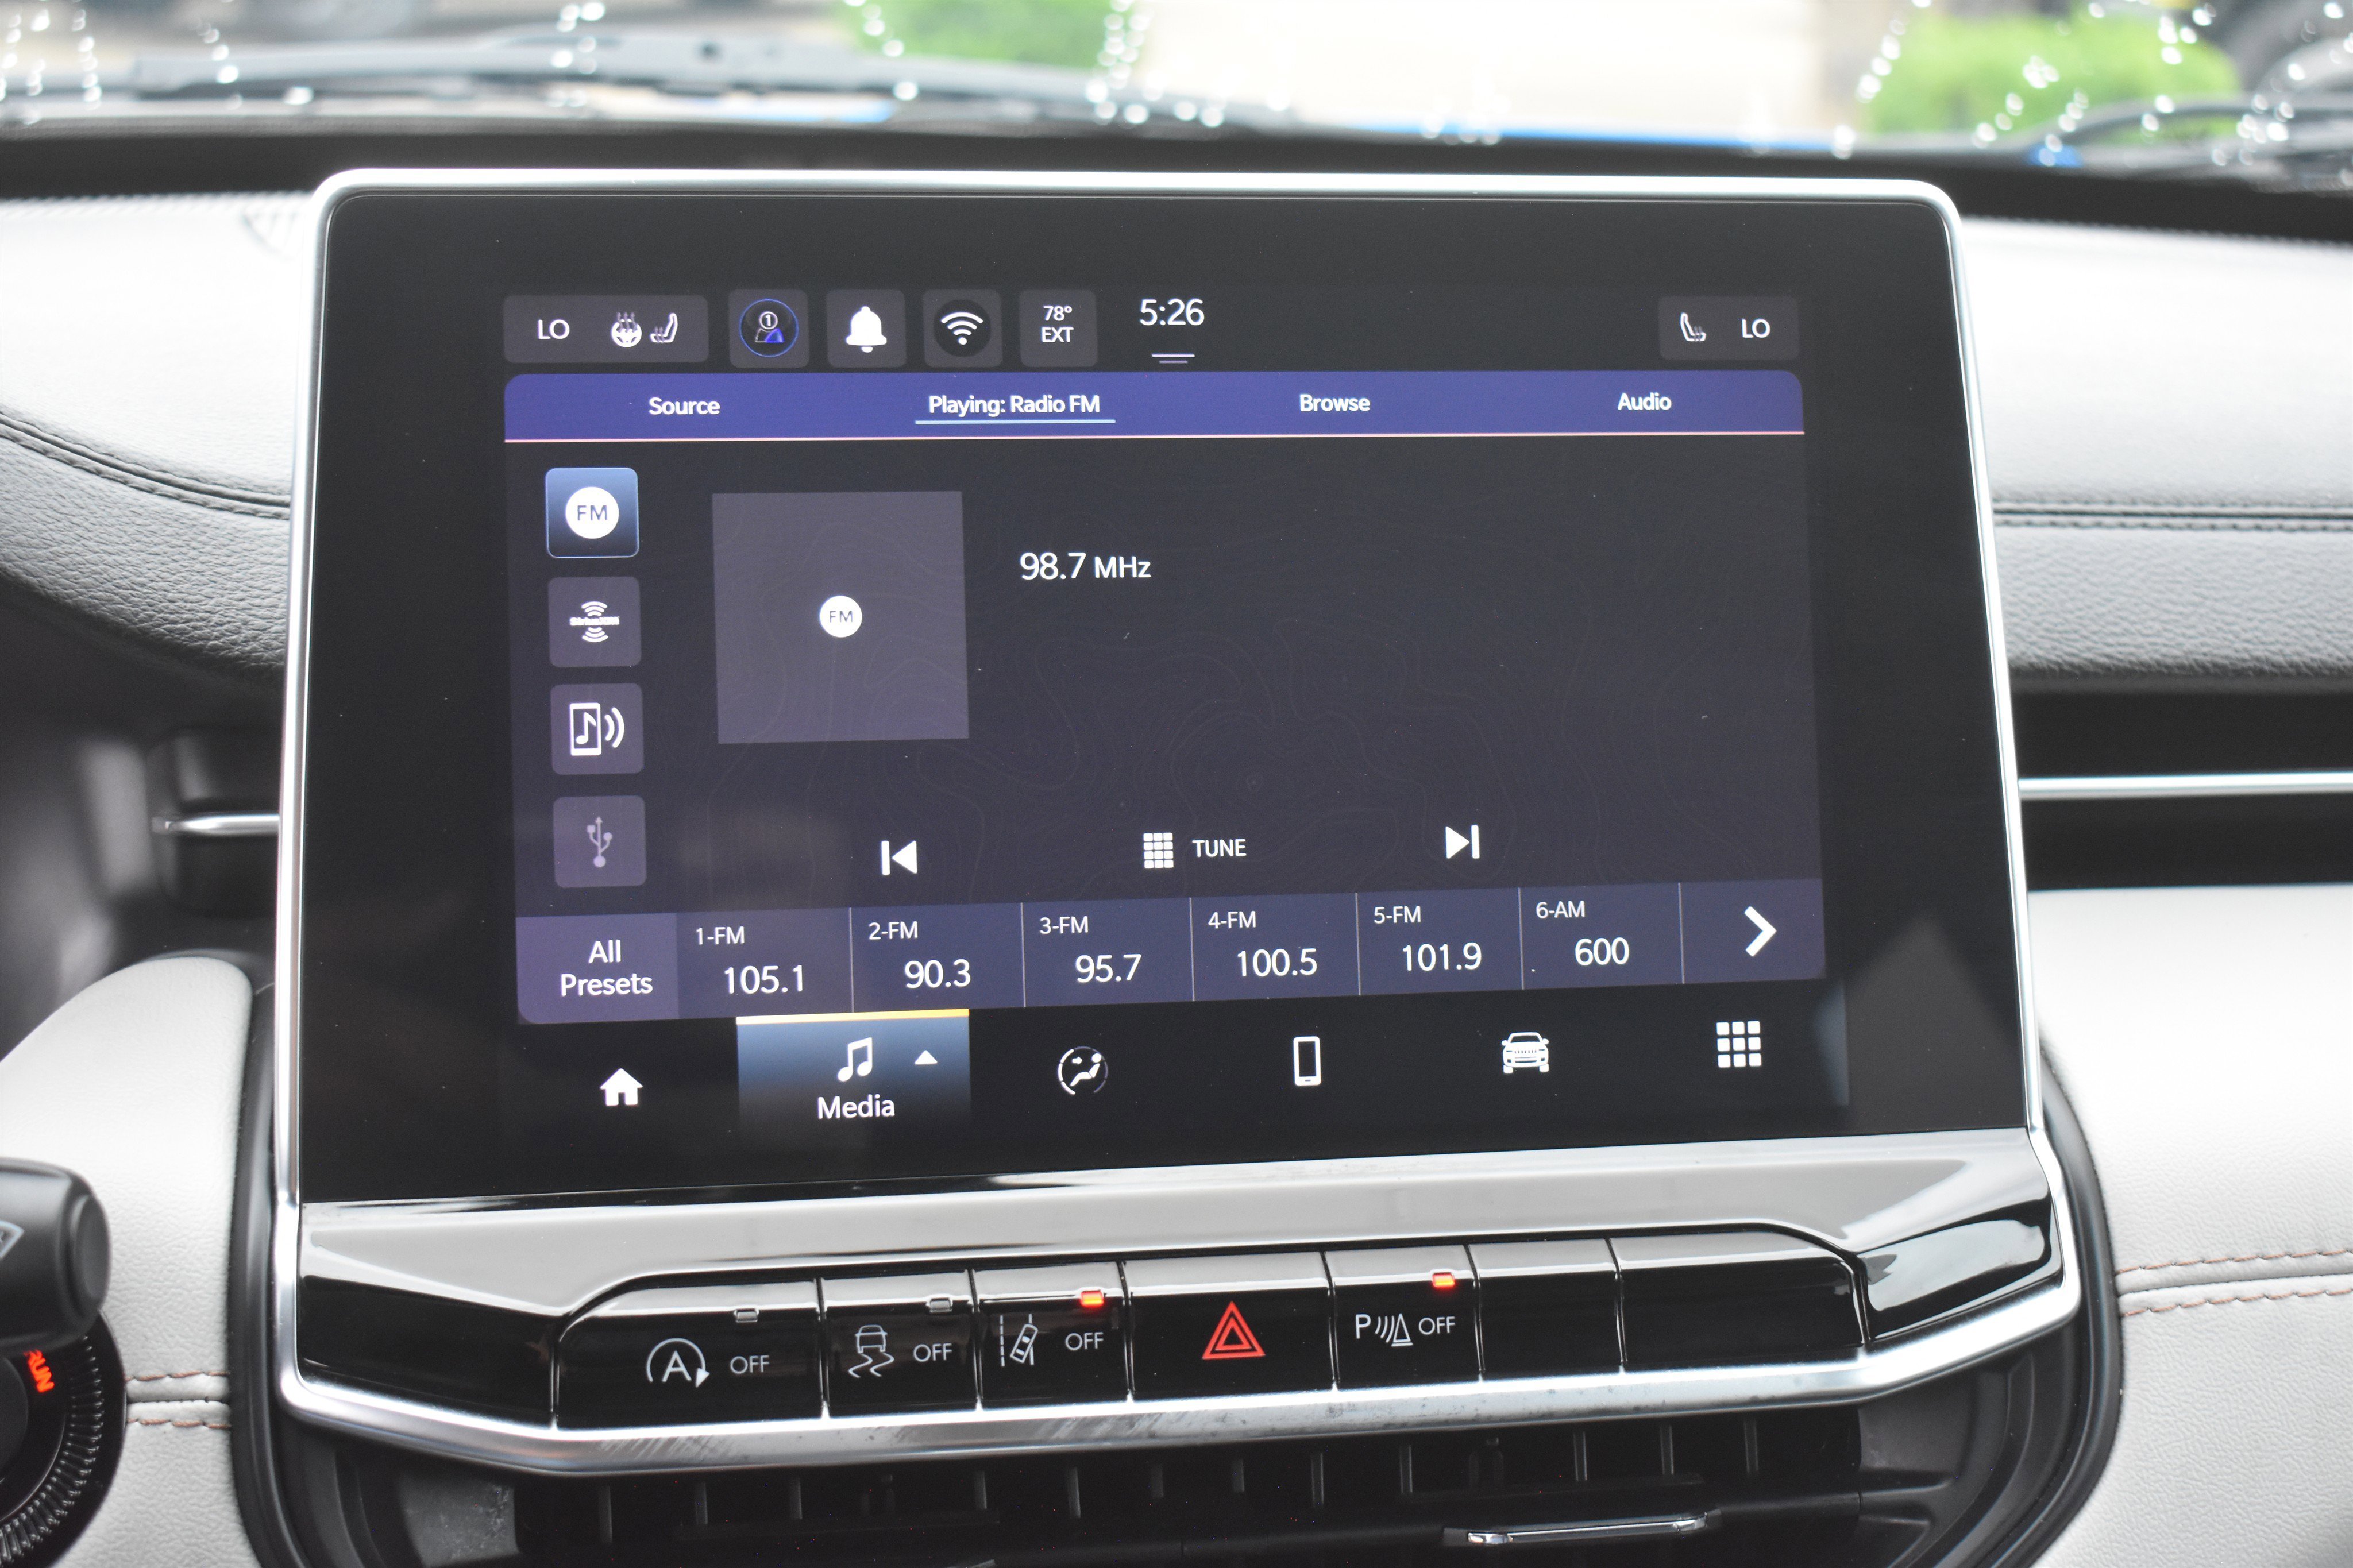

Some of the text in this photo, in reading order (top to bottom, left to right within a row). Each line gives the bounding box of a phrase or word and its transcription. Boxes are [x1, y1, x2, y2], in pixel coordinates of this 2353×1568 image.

[765, 314, 772, 327] 1
[1043, 305, 1073, 322] 78°
[1140, 298, 1205, 326] 5:26
[538, 319, 570, 339] LO
[1041, 326, 1074, 343] EXT
[1741, 318, 1771, 338] LO
[649, 397, 720, 415] Source
[929, 394, 1100, 418] Playing: Radio FM
[1299, 393, 1371, 412] Browse
[1617, 392, 1672, 410] Audio
[577, 505, 607, 521] FM
[1020, 552, 1152, 580] 98.7 MHz
[829, 610, 853, 623] FM
[1191, 839, 1247, 858] TUNE
[1208, 910, 1256, 929] 4-FM
[1374, 905, 1421, 924] 5-FM
[1536, 900, 1586, 919] 6-AM
[869, 921, 918, 940] 2-FM
[1040, 916, 1089, 934] 3-FM
[696, 926, 745, 945] 1-FM
[588, 939, 622, 964] All
[1402, 942, 1482, 971] 101.9
[1575, 937, 1630, 966] 600
[1075, 953, 1141, 983] 95.7
[1237, 948, 1317, 977] 100.5
[724, 964, 803, 994] 105.1
[904, 959, 971, 989] 90.3
[561, 973, 653, 997] Presets
[817, 1094, 895, 1119] Media
[1355, 1314, 1456, 1339] P OFF
[1065, 1331, 1104, 1351] OFF
[913, 1343, 952, 1362] OFF
[662, 1350, 770, 1382] A OFF
